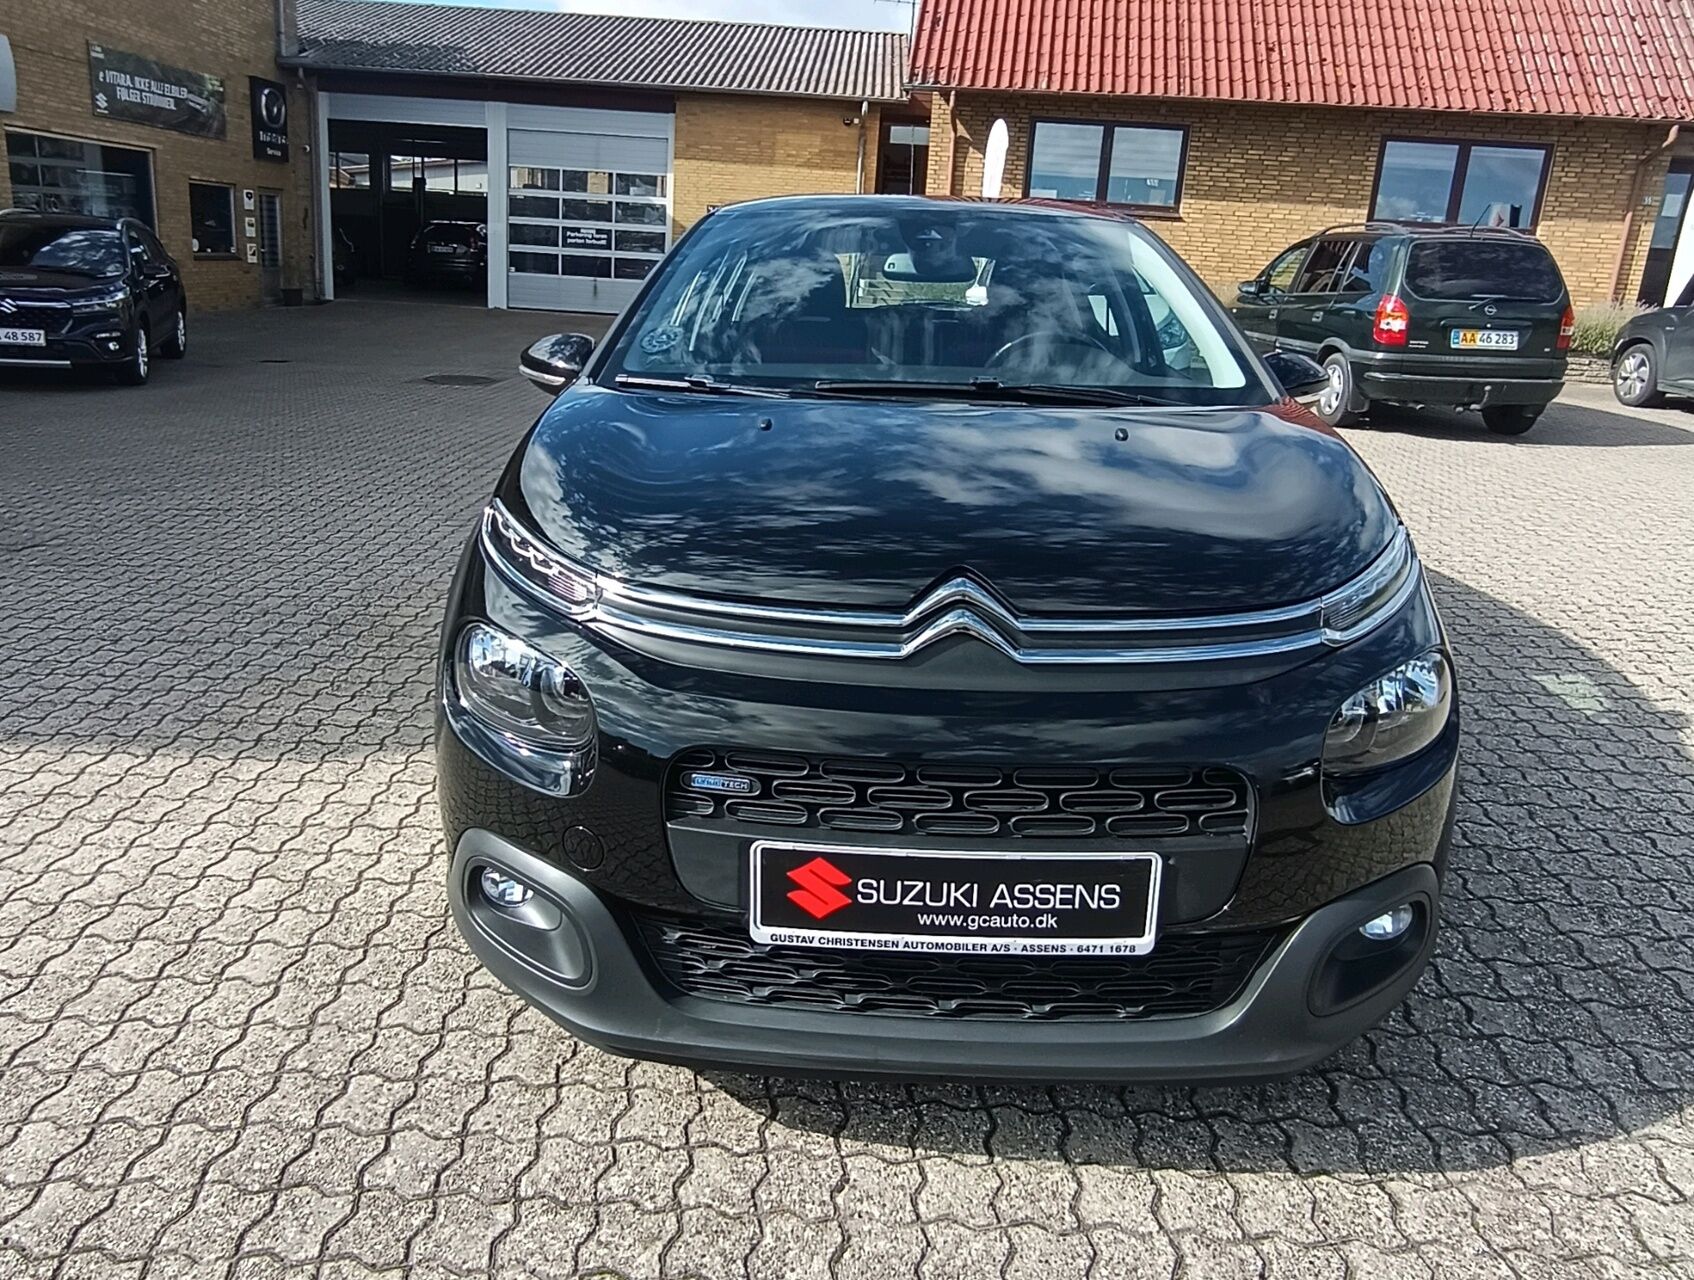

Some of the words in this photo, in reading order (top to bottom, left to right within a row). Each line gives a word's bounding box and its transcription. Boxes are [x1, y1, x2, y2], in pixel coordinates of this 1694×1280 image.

[98, 71, 104, 82] e
[4, 331, 19, 341] 48
[20, 331, 42, 342] 587
[1461, 332, 1476, 344] AA
[1479, 332, 1492, 344] 46
[1495, 333, 1515, 345] 283
[856, 878, 979, 908] SUZUKI
[989, 883, 1121, 910] ASSENS
[917, 913, 1058, 930] www.gcauto.dk
[770, 933, 815, 945] GUSTAV
[817, 935, 900, 949] CHRISTENSEN
[902, 940, 988, 953] AUTOMOBILER
[990, 943, 1011, 953] A/S
[1021, 944, 1067, 954] ASSENS
[1077, 944, 1104, 954] 6471
[1109, 944, 1136, 954] 1678
